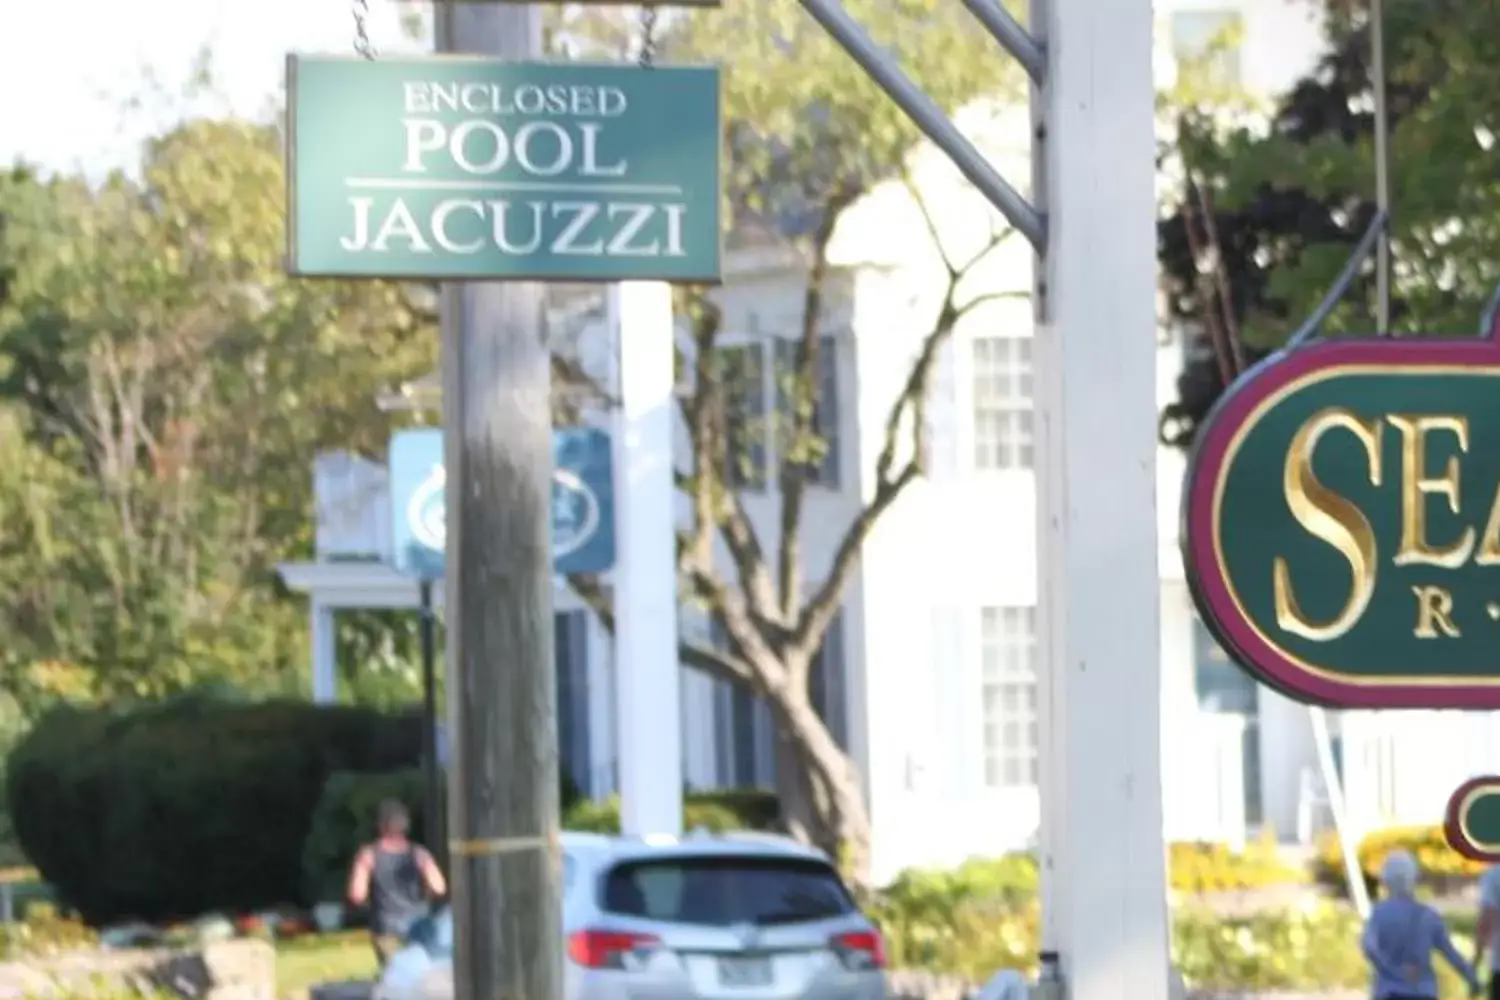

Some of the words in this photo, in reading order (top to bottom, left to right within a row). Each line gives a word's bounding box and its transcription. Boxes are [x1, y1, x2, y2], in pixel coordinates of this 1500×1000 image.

[402, 82, 627, 116] ENCLOSED
[402, 118, 627, 176] POOL
[340, 196, 687, 256] JACUZZI
